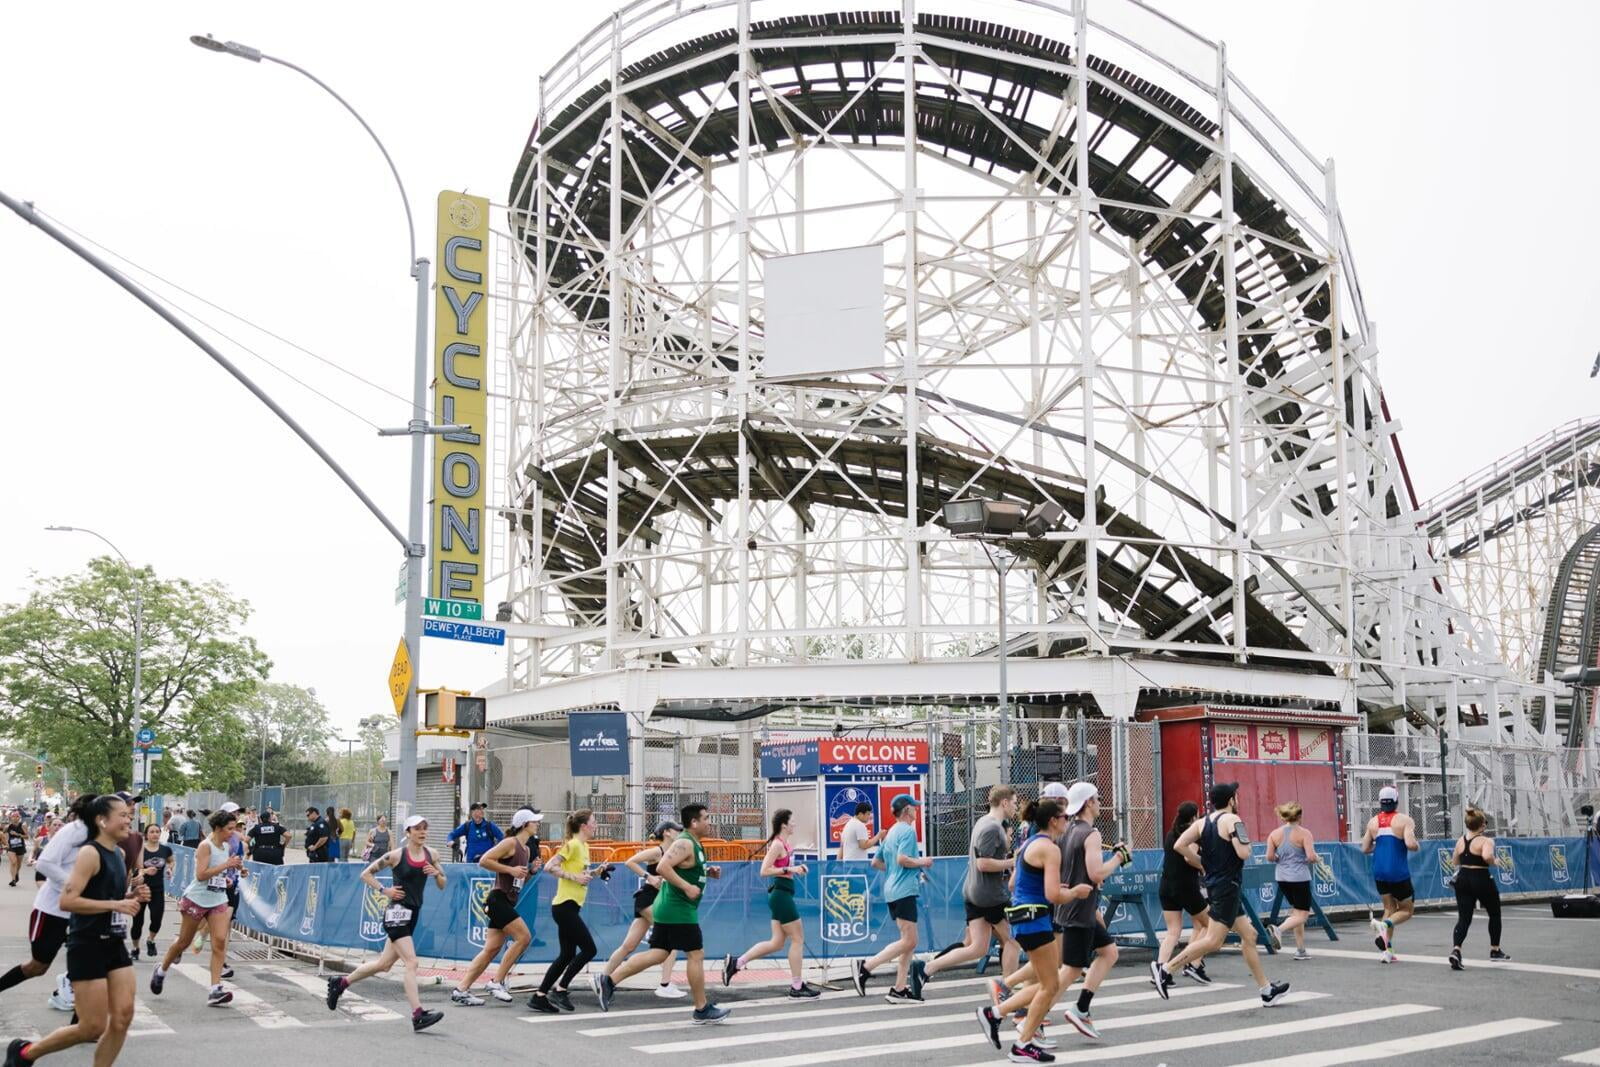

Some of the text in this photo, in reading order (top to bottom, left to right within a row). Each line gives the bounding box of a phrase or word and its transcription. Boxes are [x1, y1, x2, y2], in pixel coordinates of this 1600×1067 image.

[441, 235, 484, 603] CYCLONE
[429, 600, 477, 617] W 10 ST
[425, 620, 501, 640] DEWEY ALBERT
[453, 633, 472, 641] PLACE
[393, 660, 408, 678] DEAD
[394, 681, 405, 698] END
[772, 744, 807, 758] CYCLONE
[832, 744, 917, 761] CYCLONE
[858, 764, 894, 773] TICKETS
[1111, 875, 1124, 884] LINE
[1135, 874, 1143, 883] DO
[1145, 873, 1158, 883] NOT
[1317, 883, 1334, 893] RBC
[828, 922, 864, 937] RBC
